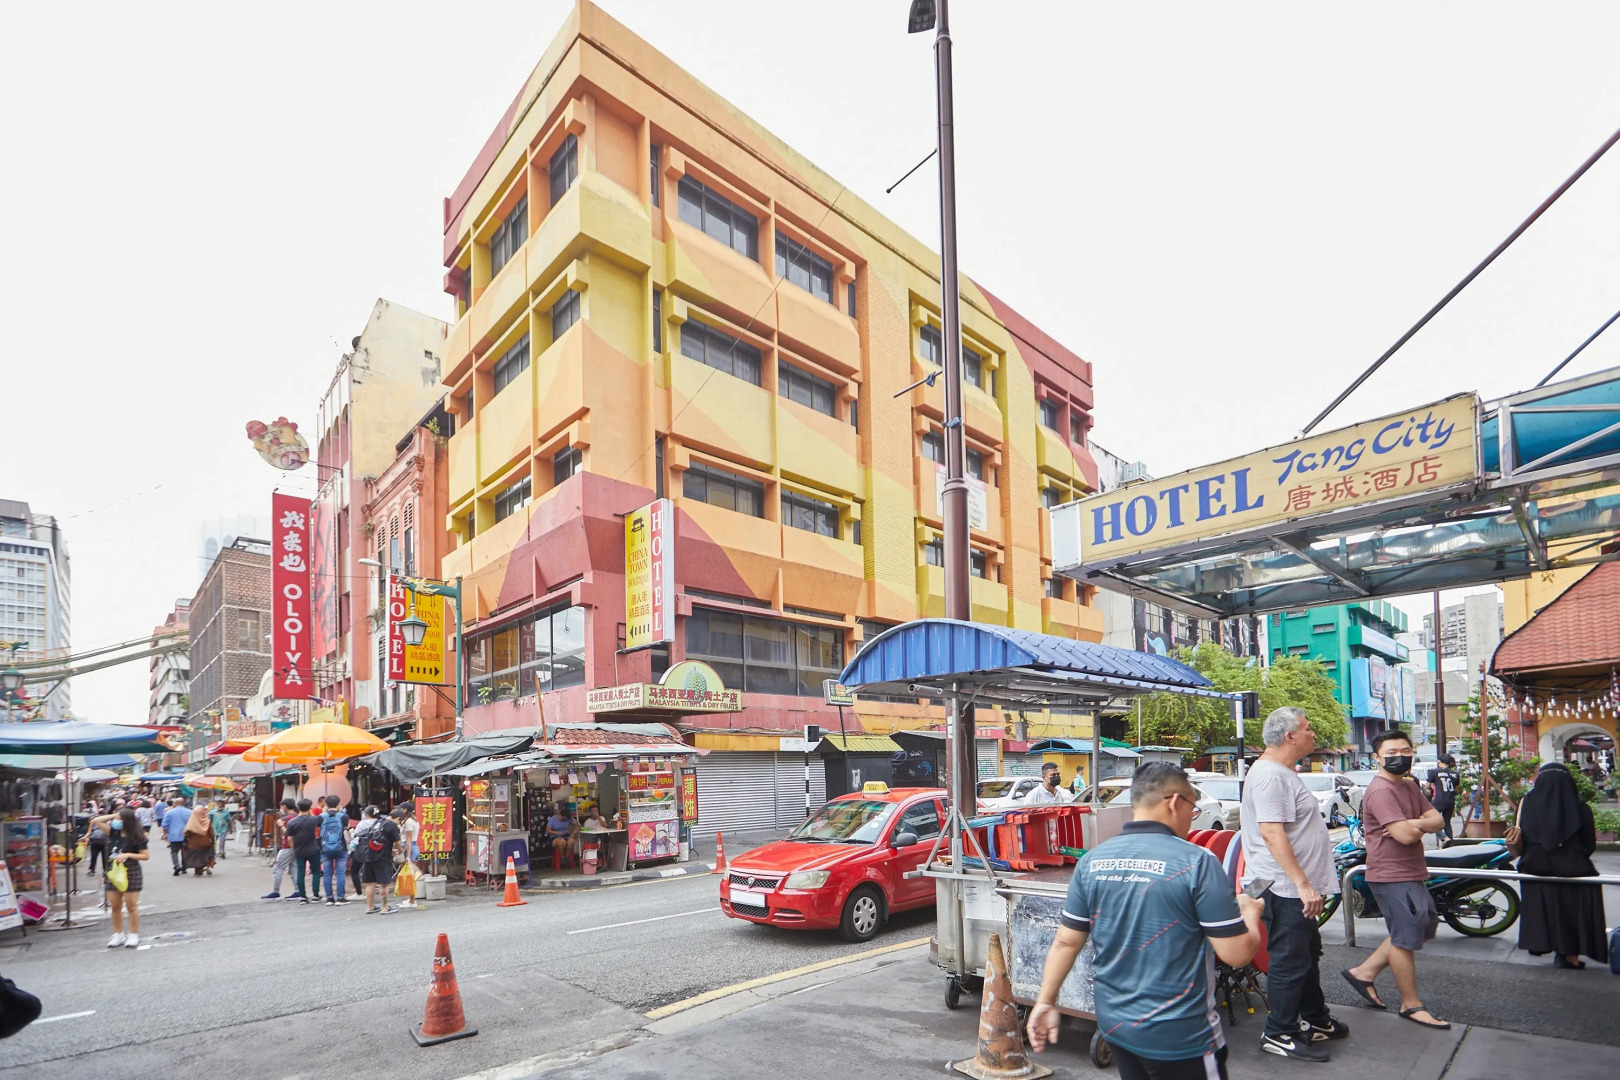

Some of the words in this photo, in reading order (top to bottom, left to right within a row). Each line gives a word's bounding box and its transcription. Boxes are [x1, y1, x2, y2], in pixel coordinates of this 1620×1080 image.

[1271, 438, 1367, 486] Tang
[1371, 411, 1456, 455] City
[1282, 455, 1444, 513] 唐城酒店
[1091, 467, 1265, 547] HOTEL
[627, 547, 649, 564] CHINA
[628, 559, 649, 575] TOWN
[651, 511, 663, 632] HOTEL
[416, 609, 441, 621] HINA
[390, 582, 405, 674] HOTEL
[588, 703, 606, 711] MALAYSIA
[628, 699, 641, 707] FRUITS
[648, 698, 680, 707] MALAYSIA
[227, 724, 269, 733] CHINATWN
[684, 777, 695, 817] 薄饼
[421, 802, 447, 852] 薄饼
[418, 852, 450, 861] POAH
[1091, 860, 1116, 870] MPSBP
[1118, 860, 1164, 873] EXCELLENCE
